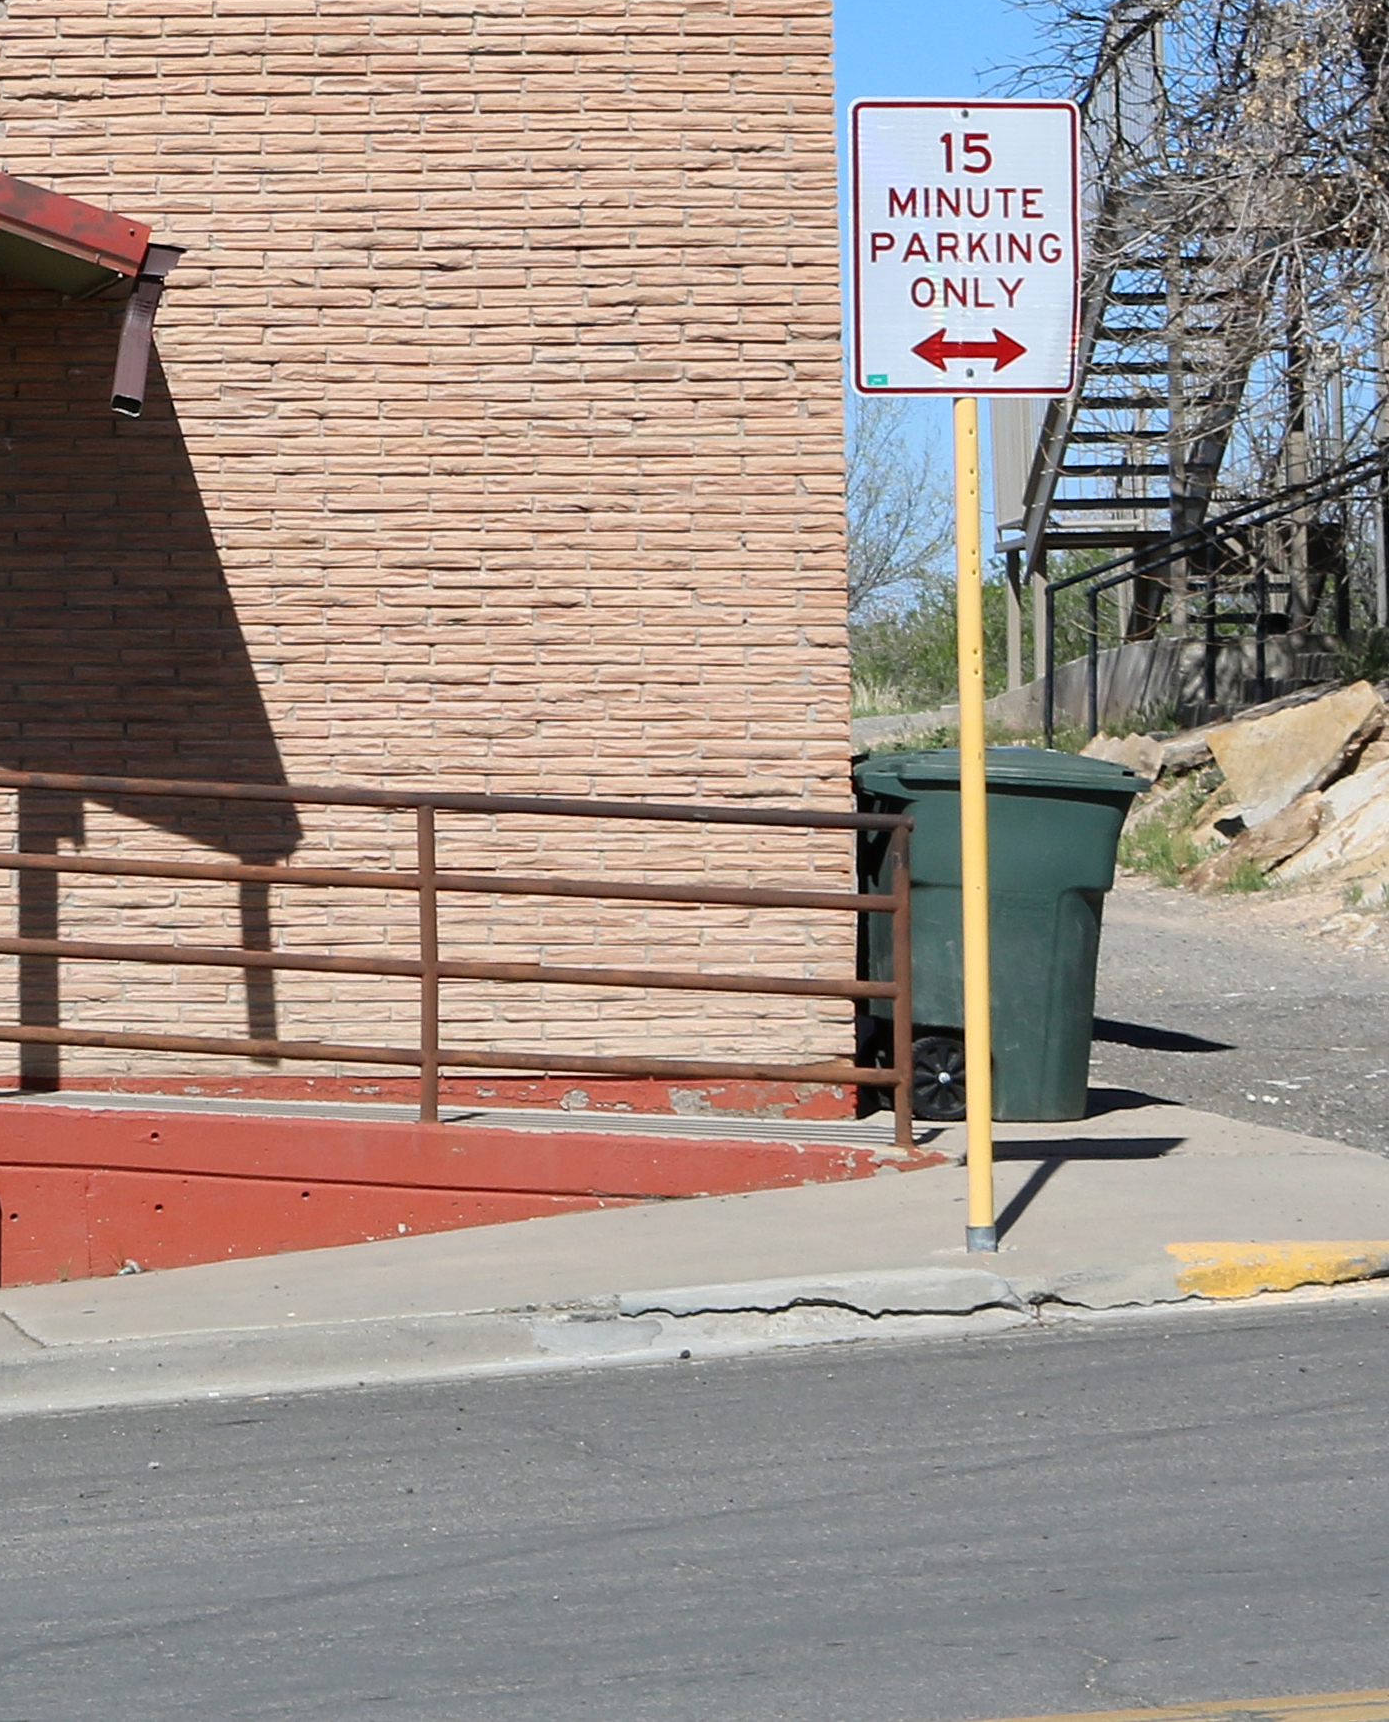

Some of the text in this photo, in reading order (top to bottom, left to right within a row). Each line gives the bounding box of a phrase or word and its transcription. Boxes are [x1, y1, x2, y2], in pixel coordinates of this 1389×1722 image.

[940, 132, 992, 174] 15
[888, 187, 1044, 219] MINUTE
[870, 232, 1063, 264] PARKING
[910, 277, 1025, 308] ONLY
